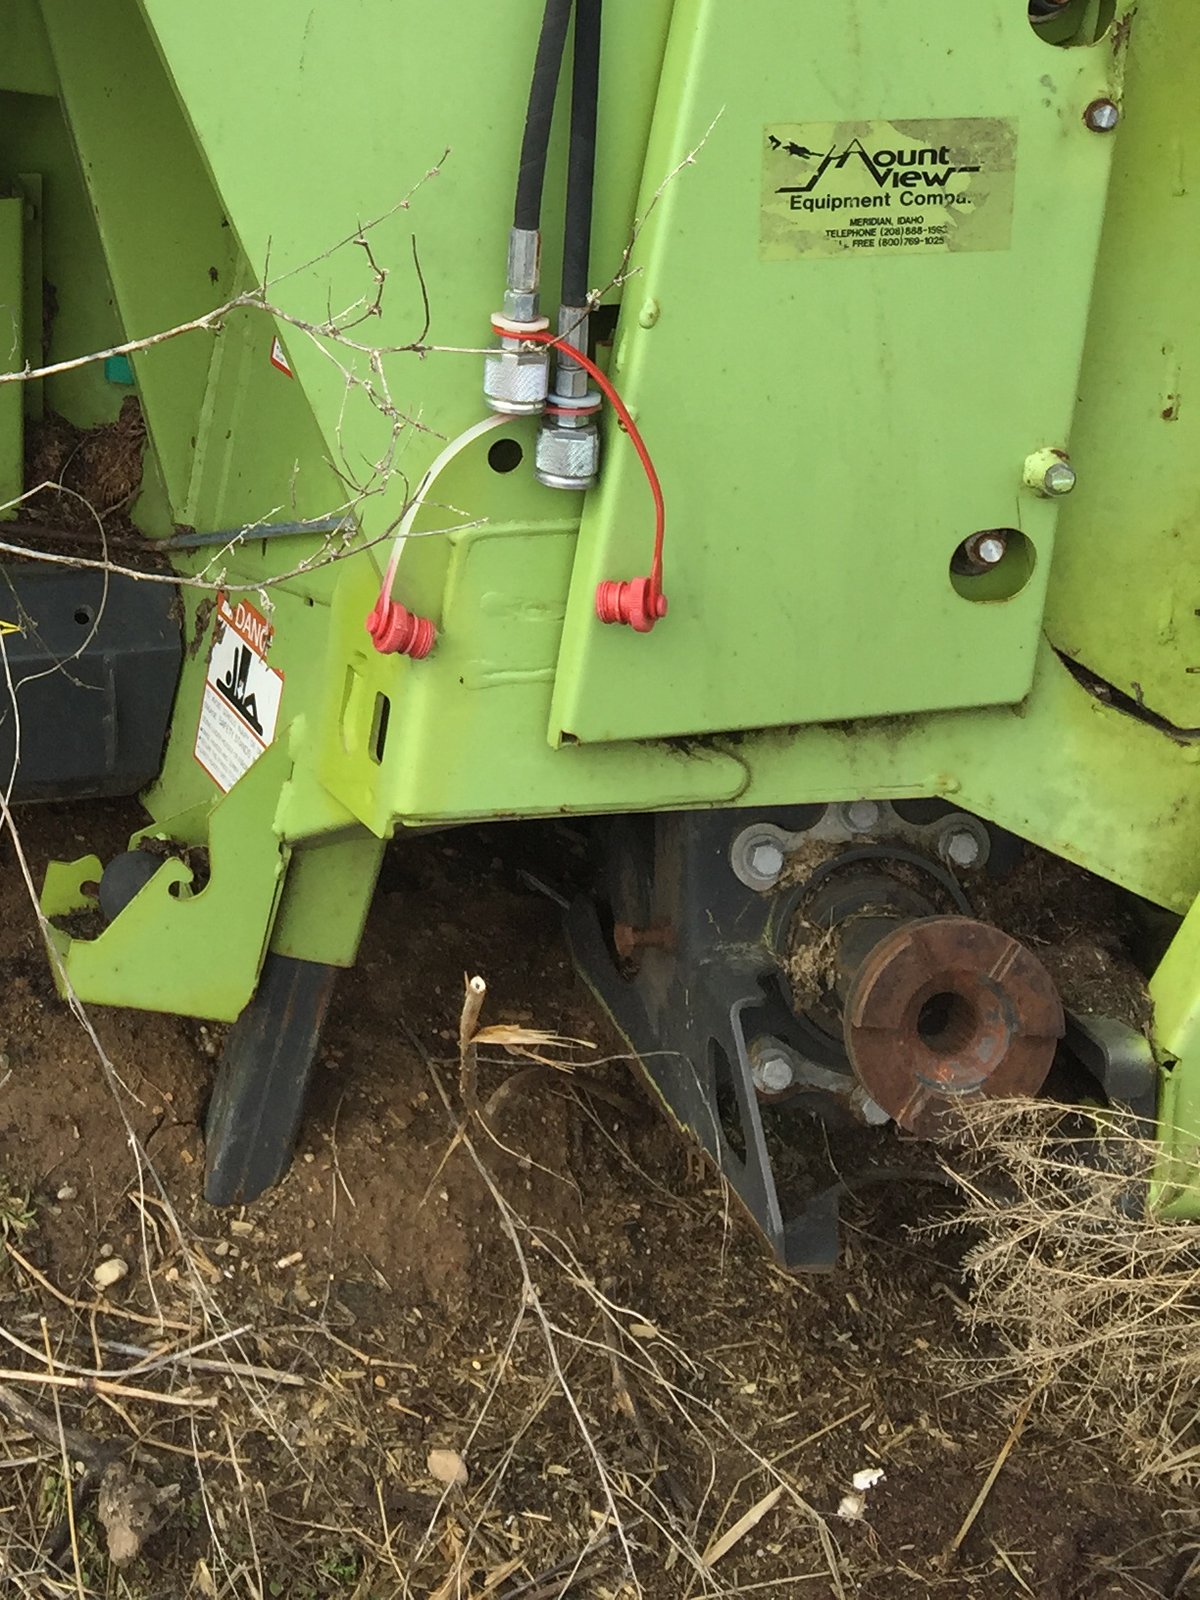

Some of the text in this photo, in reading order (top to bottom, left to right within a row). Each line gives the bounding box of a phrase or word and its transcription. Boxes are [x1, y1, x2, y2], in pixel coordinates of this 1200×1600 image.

[867, 166, 960, 189] View
[790, 192, 891, 212] Equipment
[896, 215, 924, 225] IDAHO
[825, 227, 877, 238] TELEPHONE
[852, 238, 875, 248] FREE
[235, 602, 272, 654] DANG
